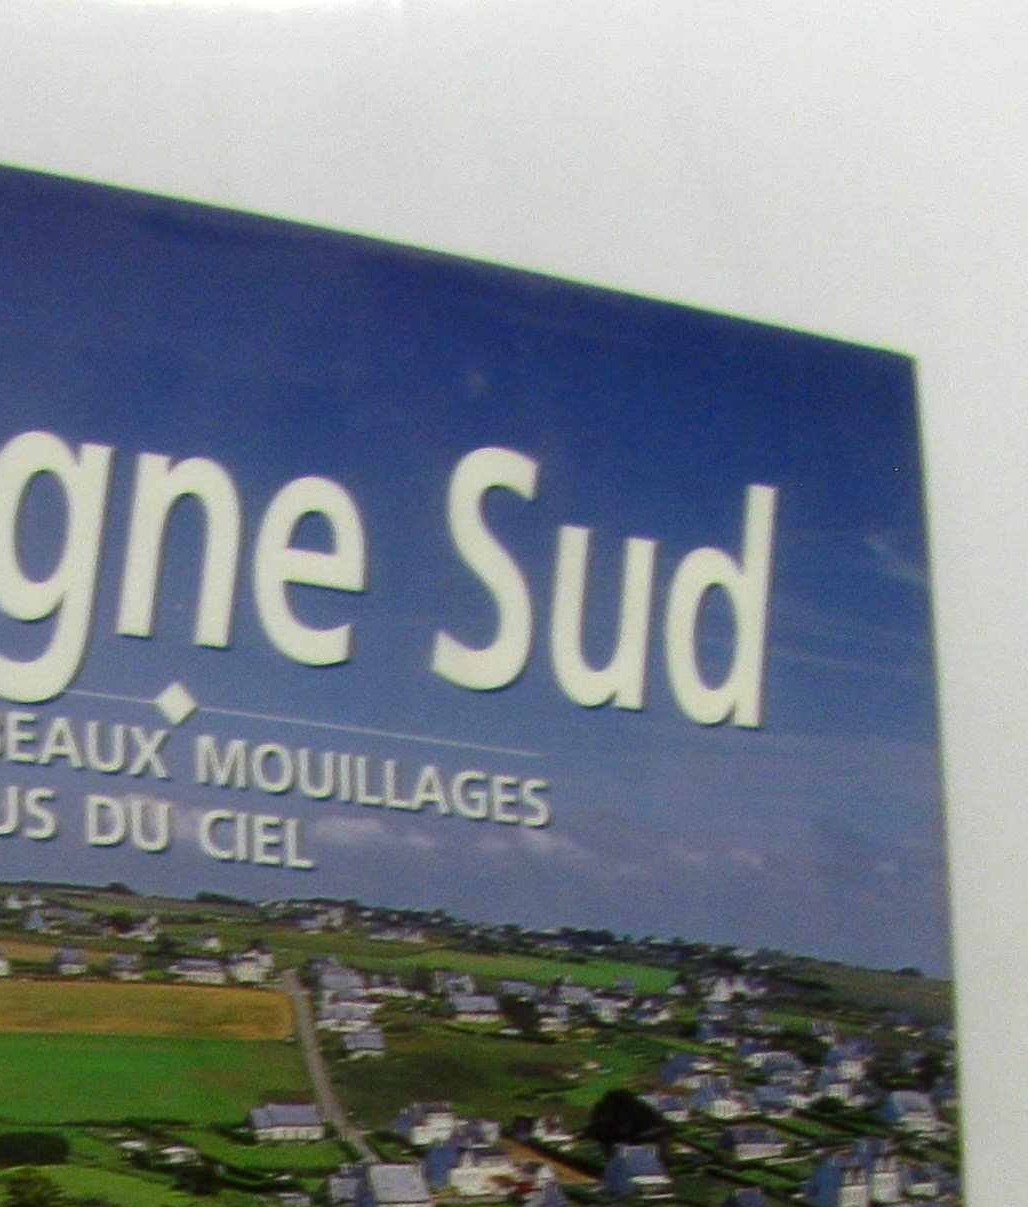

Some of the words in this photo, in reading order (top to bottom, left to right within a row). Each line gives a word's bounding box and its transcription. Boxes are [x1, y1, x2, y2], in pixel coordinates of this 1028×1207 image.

[429, 446, 778, 728] Sud
[192, 734, 552, 828] MOUILLAGES
[85, 793, 172, 854] DU
[196, 808, 315, 870] CIEL
